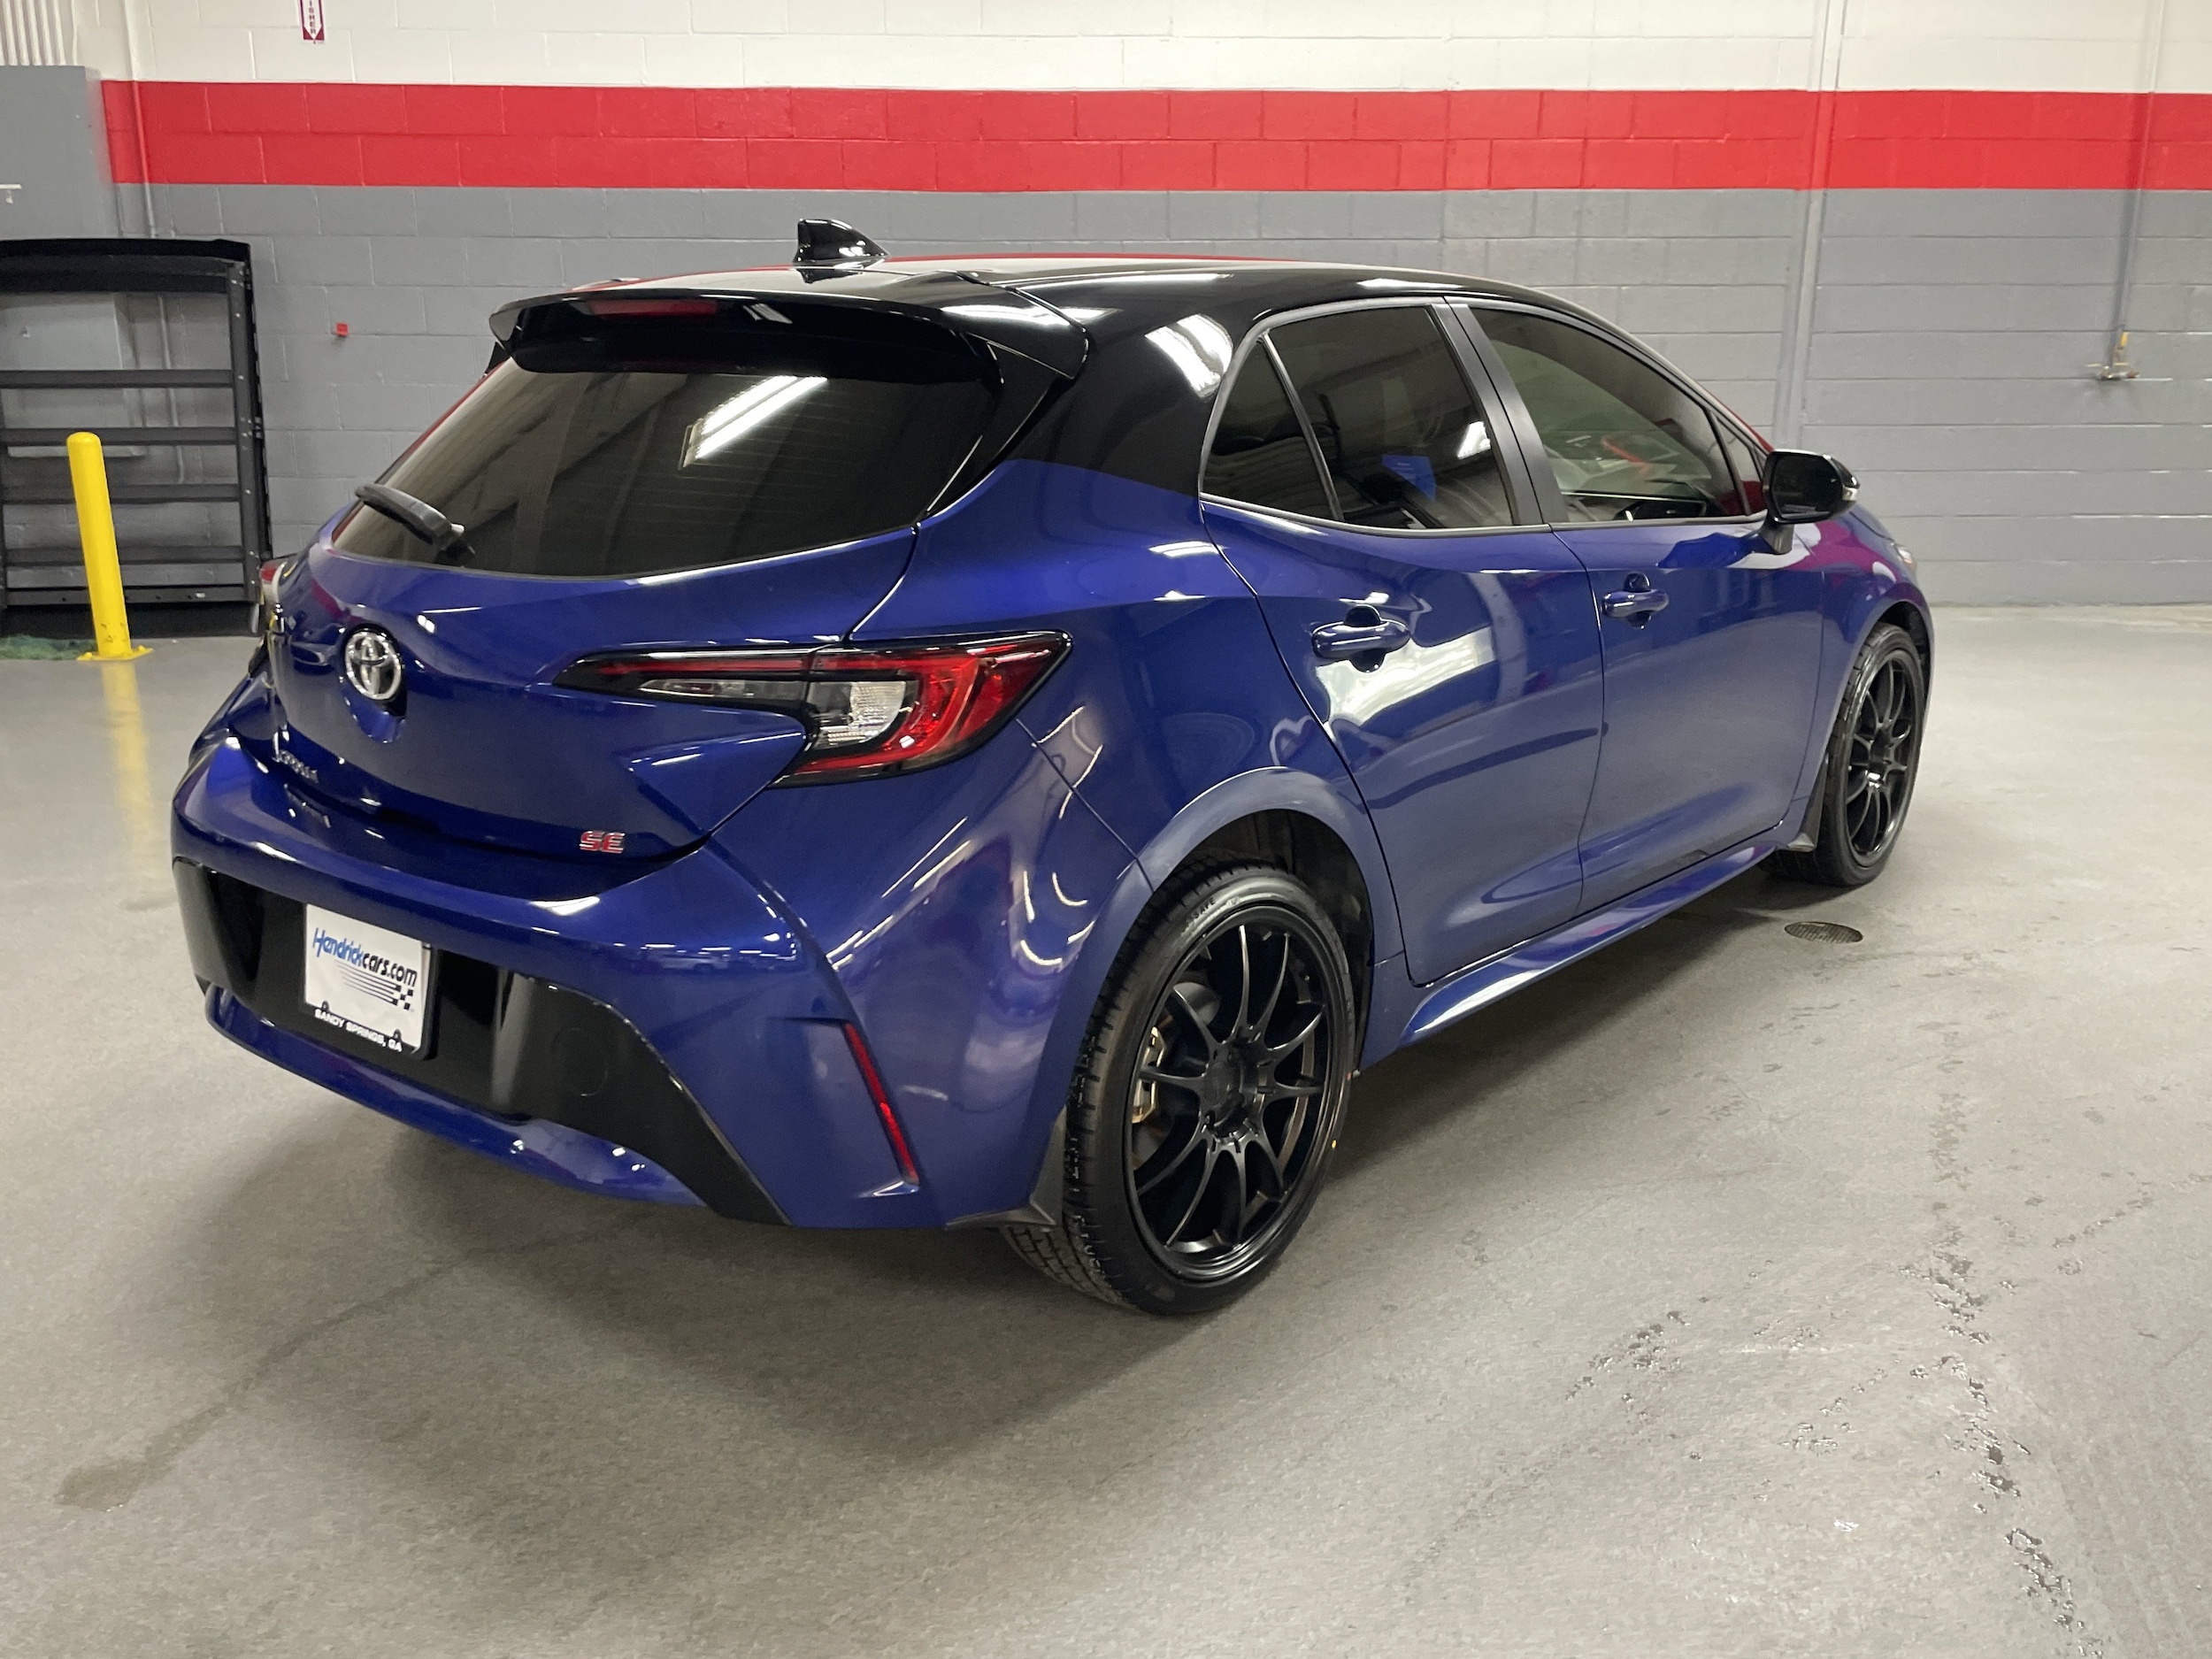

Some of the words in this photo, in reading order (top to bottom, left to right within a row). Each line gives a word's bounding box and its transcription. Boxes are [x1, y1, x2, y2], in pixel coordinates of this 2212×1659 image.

[580, 830, 625, 854] SE
[312, 927, 418, 987] Hendrickcars.com
[314, 1009, 344, 1027] SANDY
[345, 1021, 386, 1048] SPRINGS,
[388, 1038, 402, 1052] GA
